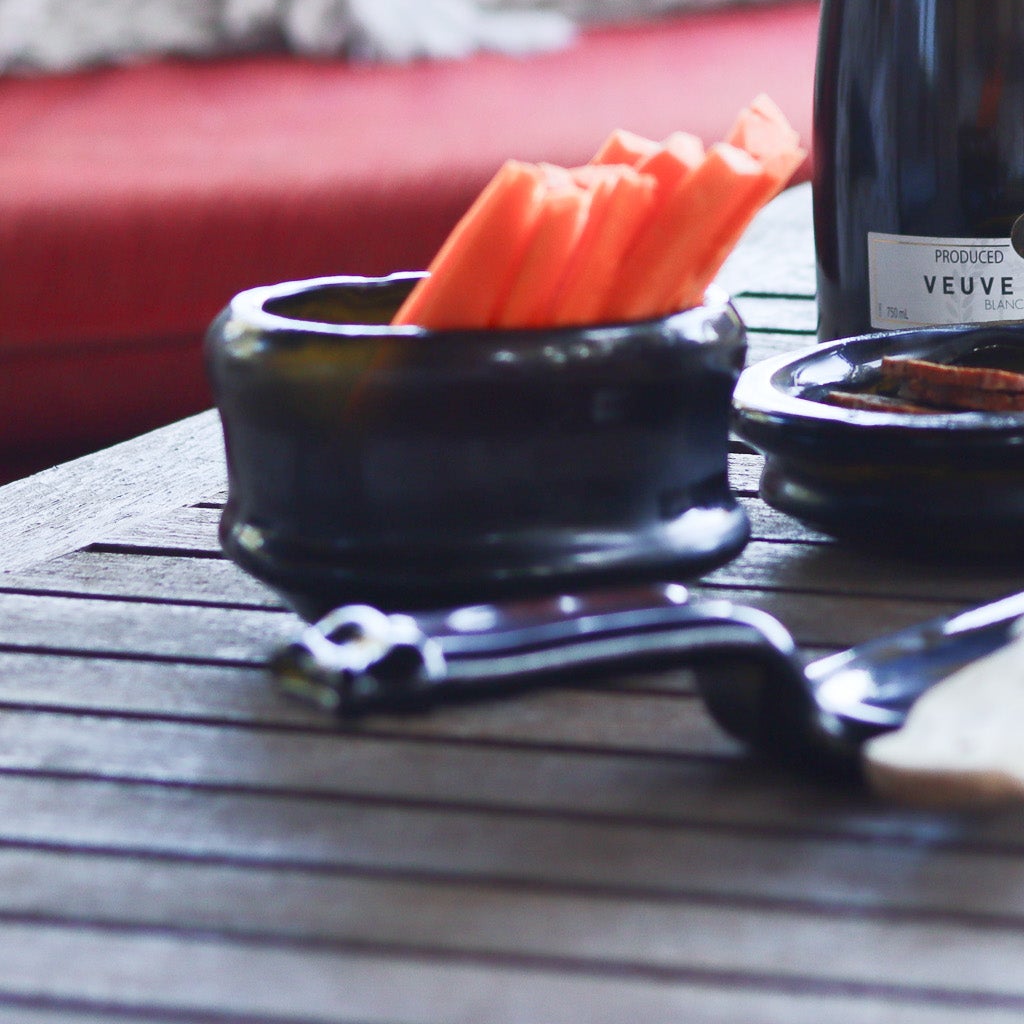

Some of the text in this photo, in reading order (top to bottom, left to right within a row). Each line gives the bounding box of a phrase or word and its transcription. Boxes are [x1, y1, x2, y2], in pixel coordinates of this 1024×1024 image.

[935, 249, 1004, 264] PRODUCED
[924, 275, 1014, 295] VEUVE
[984, 298, 1024, 311] BLANC
